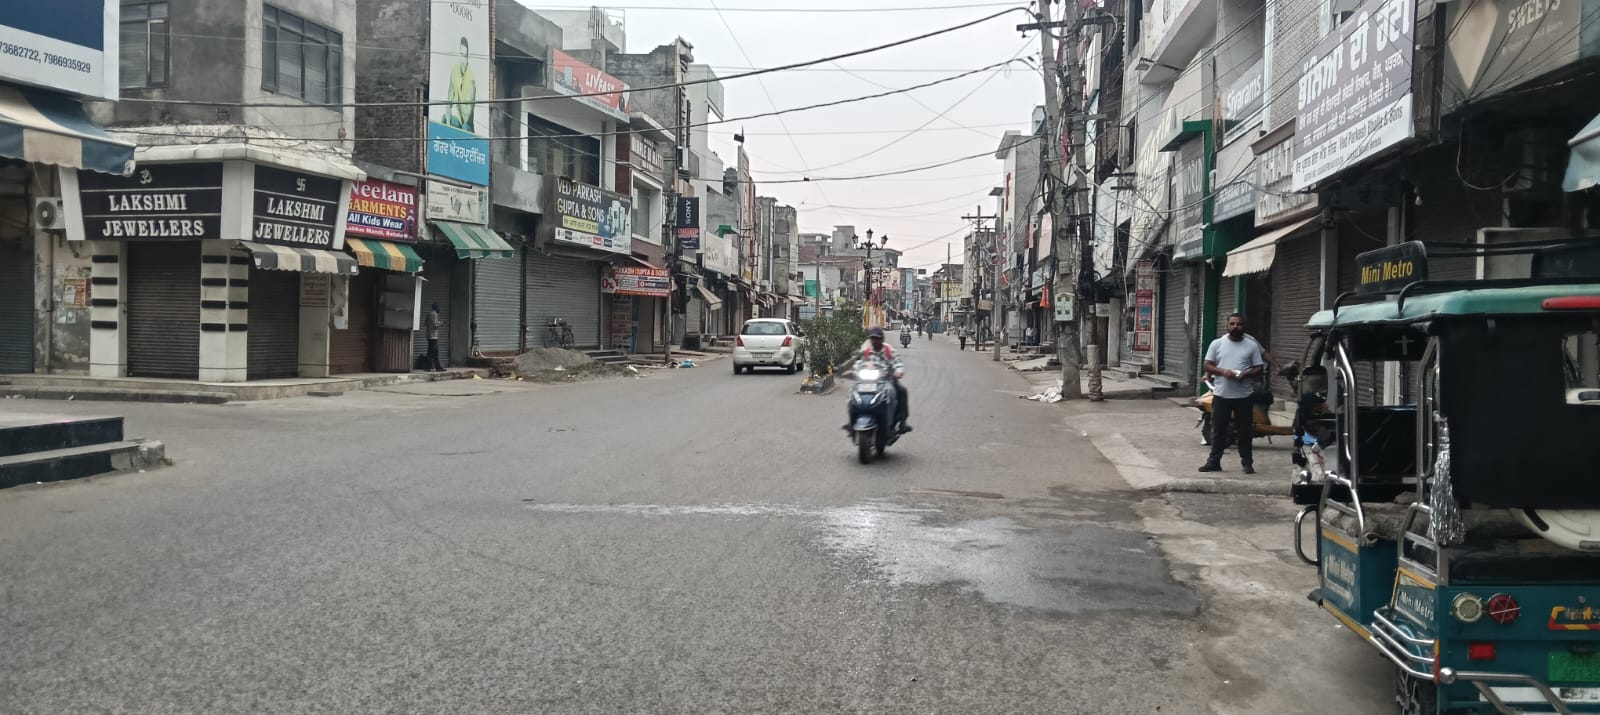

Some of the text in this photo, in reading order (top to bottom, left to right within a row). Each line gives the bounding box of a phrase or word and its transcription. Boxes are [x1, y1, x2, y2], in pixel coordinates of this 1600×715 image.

[43, 52, 91, 73] 7986935929
[351, 181, 415, 206] Neelam
[556, 177, 602, 204] VED PARKASH
[108, 193, 188, 213] LAKSHMI
[267, 197, 327, 221] LAKSHMI
[557, 198, 605, 223] GUPTA & SONS
[685, 200, 693, 225] SONY
[102, 219, 205, 239] JEWELLERS
[348, 213, 404, 230] All Kids Wear
[256, 222, 331, 246] JEWELLERS
[1361, 260, 1414, 286] Mini Metro
[1401, 591, 1435, 622] Mini Metro
